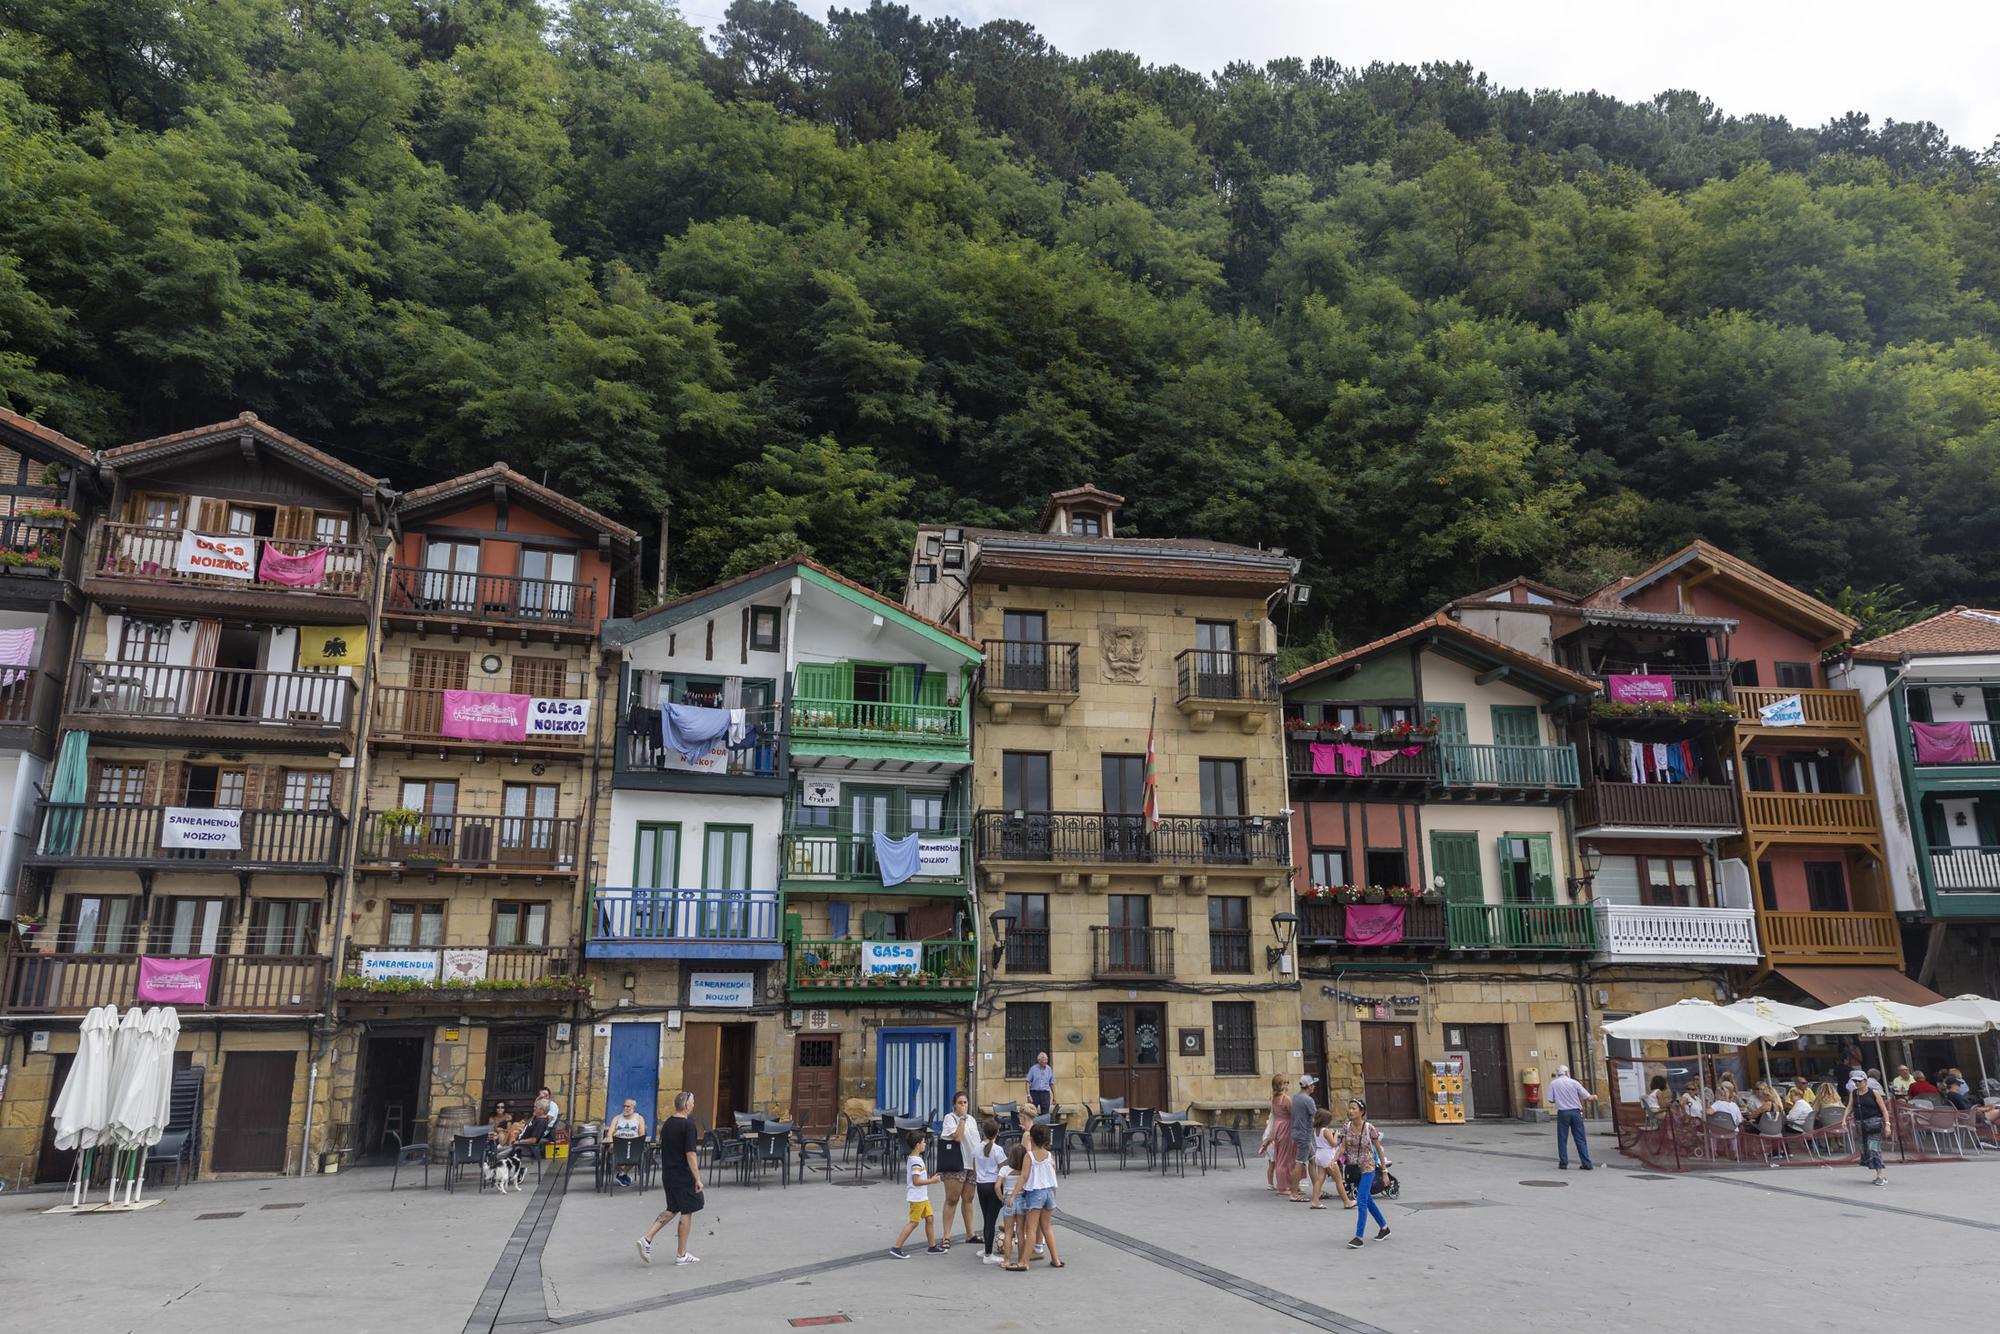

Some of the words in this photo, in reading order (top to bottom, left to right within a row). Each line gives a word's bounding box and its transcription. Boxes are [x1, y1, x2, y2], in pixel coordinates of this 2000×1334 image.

[190, 554, 250, 572] NOIZKO?
[537, 701, 582, 716] GAS-a
[534, 719, 586, 734] NOIZKO?
[183, 831, 226, 841] NOIZKO?
[872, 945, 914, 957] GAS-a
[366, 959, 433, 969] SANEAMENDUA
[1687, 1032, 1718, 1041] CERVEZAS
